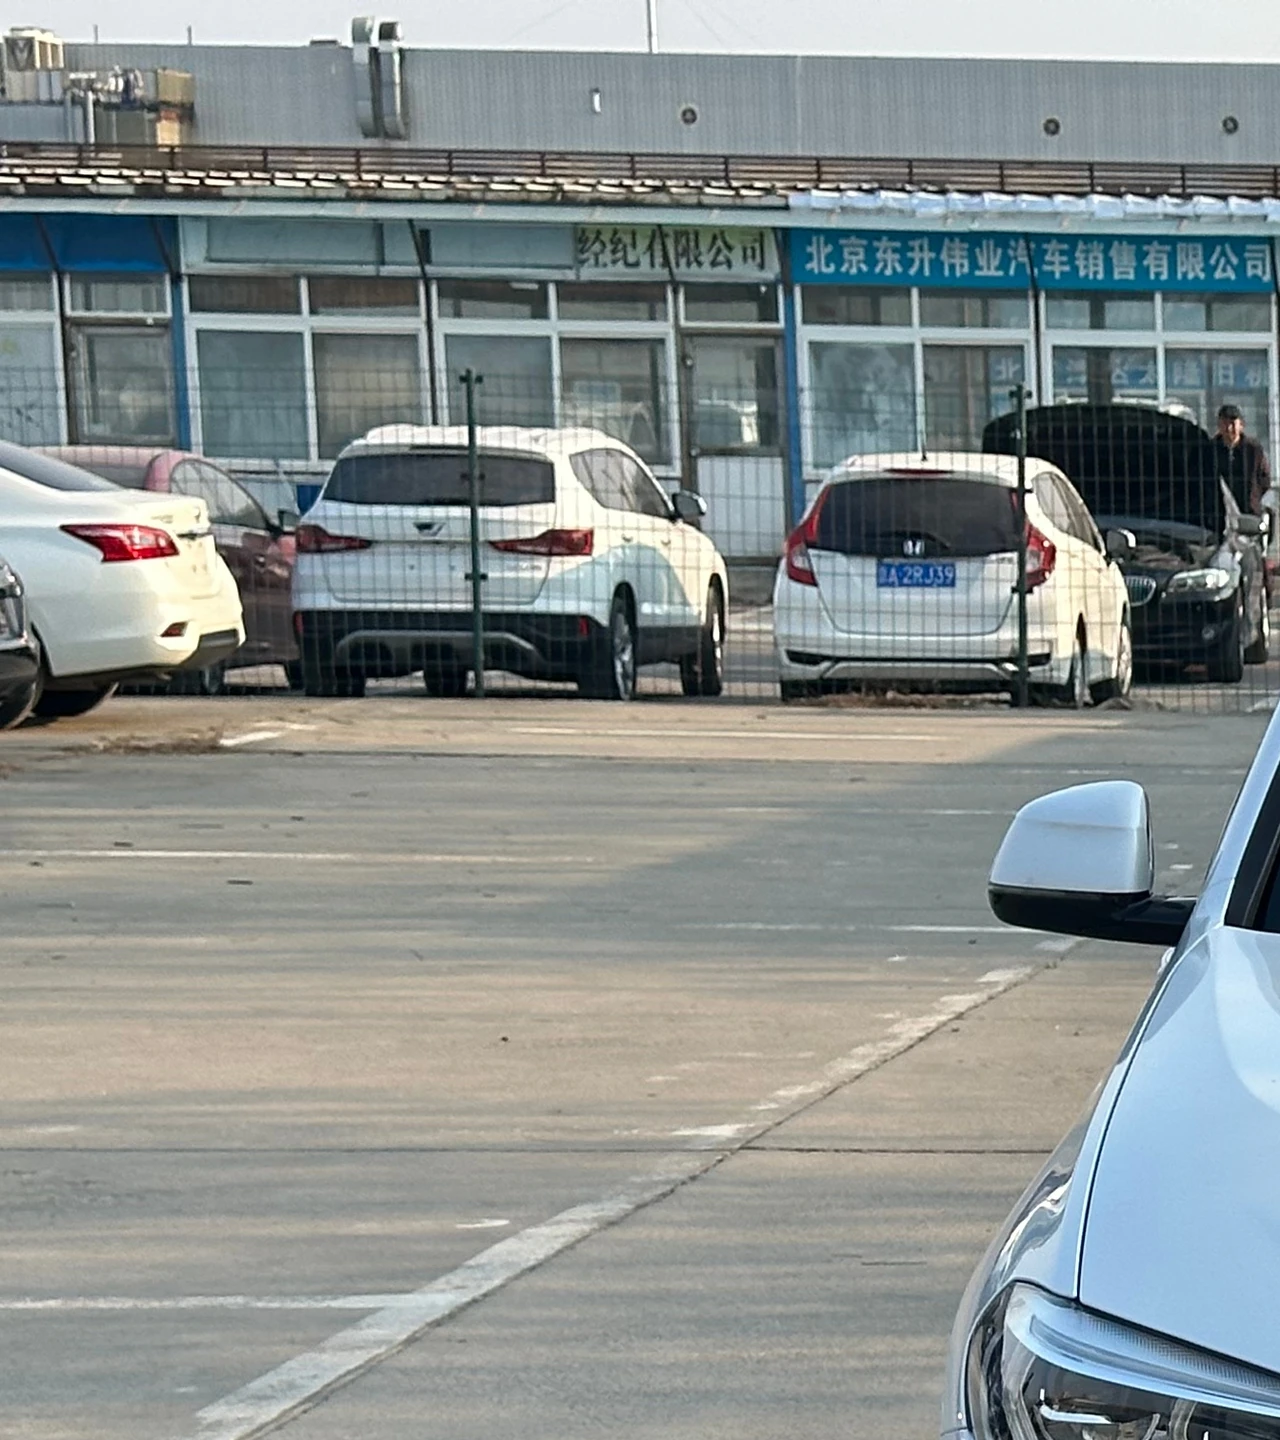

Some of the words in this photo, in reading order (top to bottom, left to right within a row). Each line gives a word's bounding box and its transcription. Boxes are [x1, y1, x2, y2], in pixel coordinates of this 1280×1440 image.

[804, 234, 1273, 281] 北京东升伟业汽车销售有限公司
